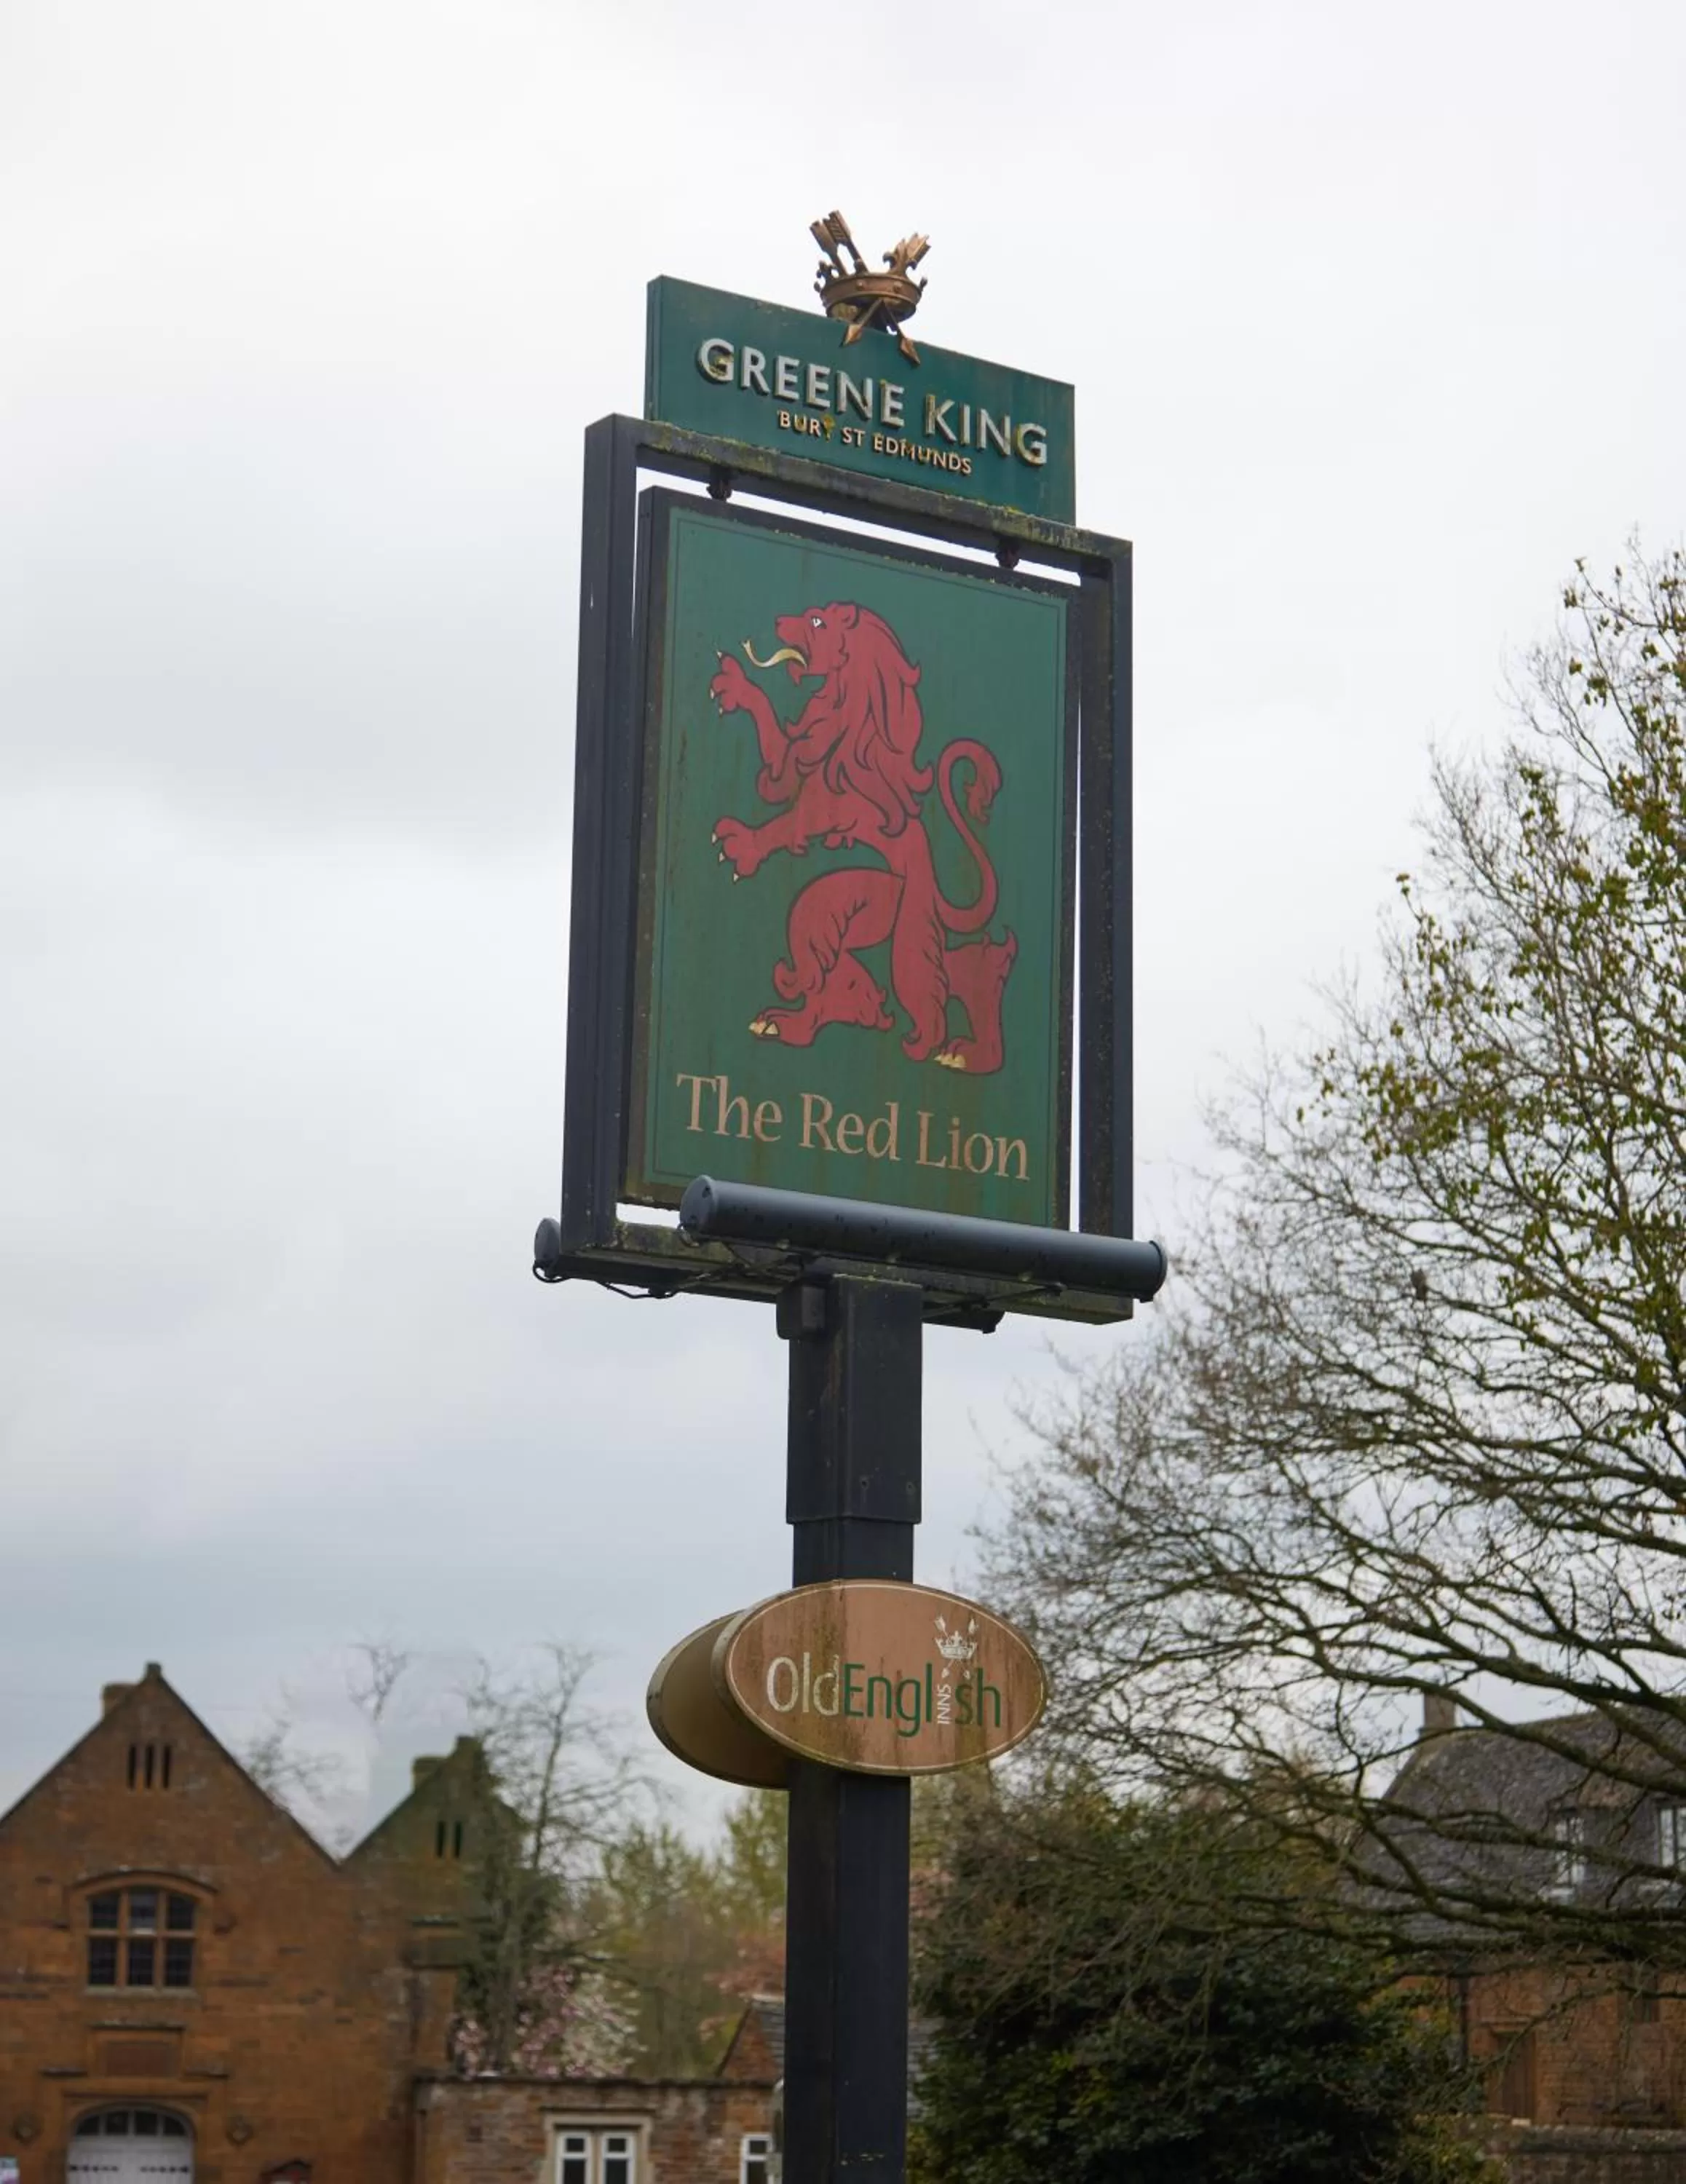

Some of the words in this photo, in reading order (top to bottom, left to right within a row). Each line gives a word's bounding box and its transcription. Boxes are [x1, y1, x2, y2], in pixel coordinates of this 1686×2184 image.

[697, 338, 904, 427] GREENE
[925, 393, 1048, 465] KING
[777, 411, 835, 442] BURY
[842, 427, 865, 447] ST
[873, 432, 973, 475] EDMUNDS
[676, 1073, 783, 1142] The
[799, 1093, 901, 1161] Red
[916, 1111, 1030, 1181] Lion
[937, 1683, 952, 1725] INNS
